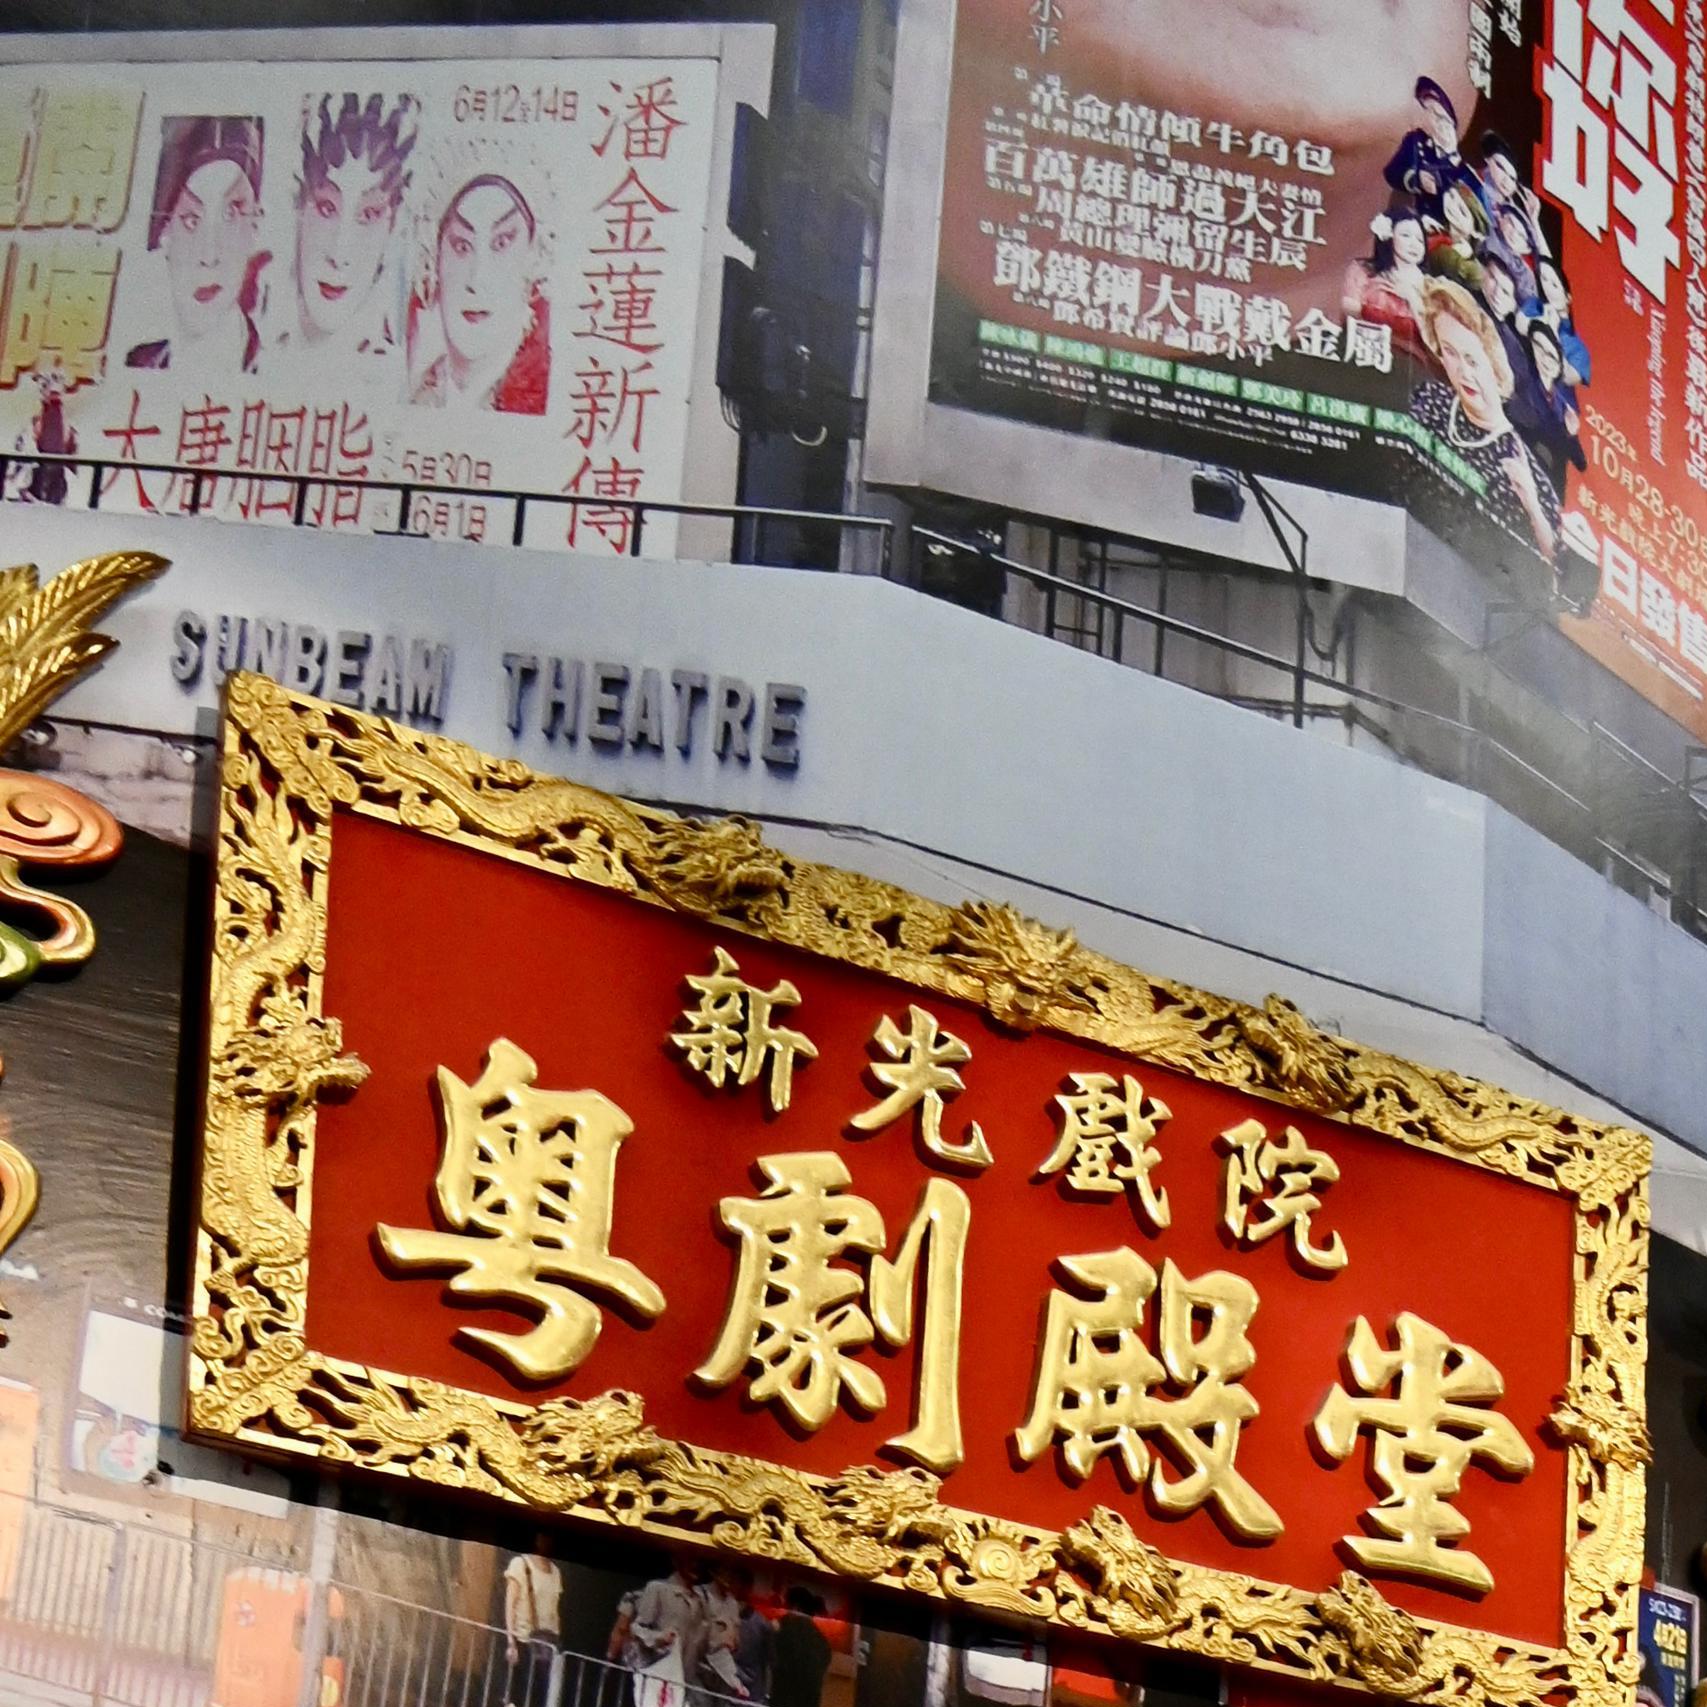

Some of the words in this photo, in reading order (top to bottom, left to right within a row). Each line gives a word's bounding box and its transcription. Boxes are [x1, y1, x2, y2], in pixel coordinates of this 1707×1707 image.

[563, 76, 687, 557] 潘金蓮新傳
[171, 610, 450, 728] SUNBEAM
[503, 652, 807, 770] THEATRE
[669, 947, 1350, 1274] 新光戲院
[374, 1036, 1534, 1597] 粵劇殿堂
